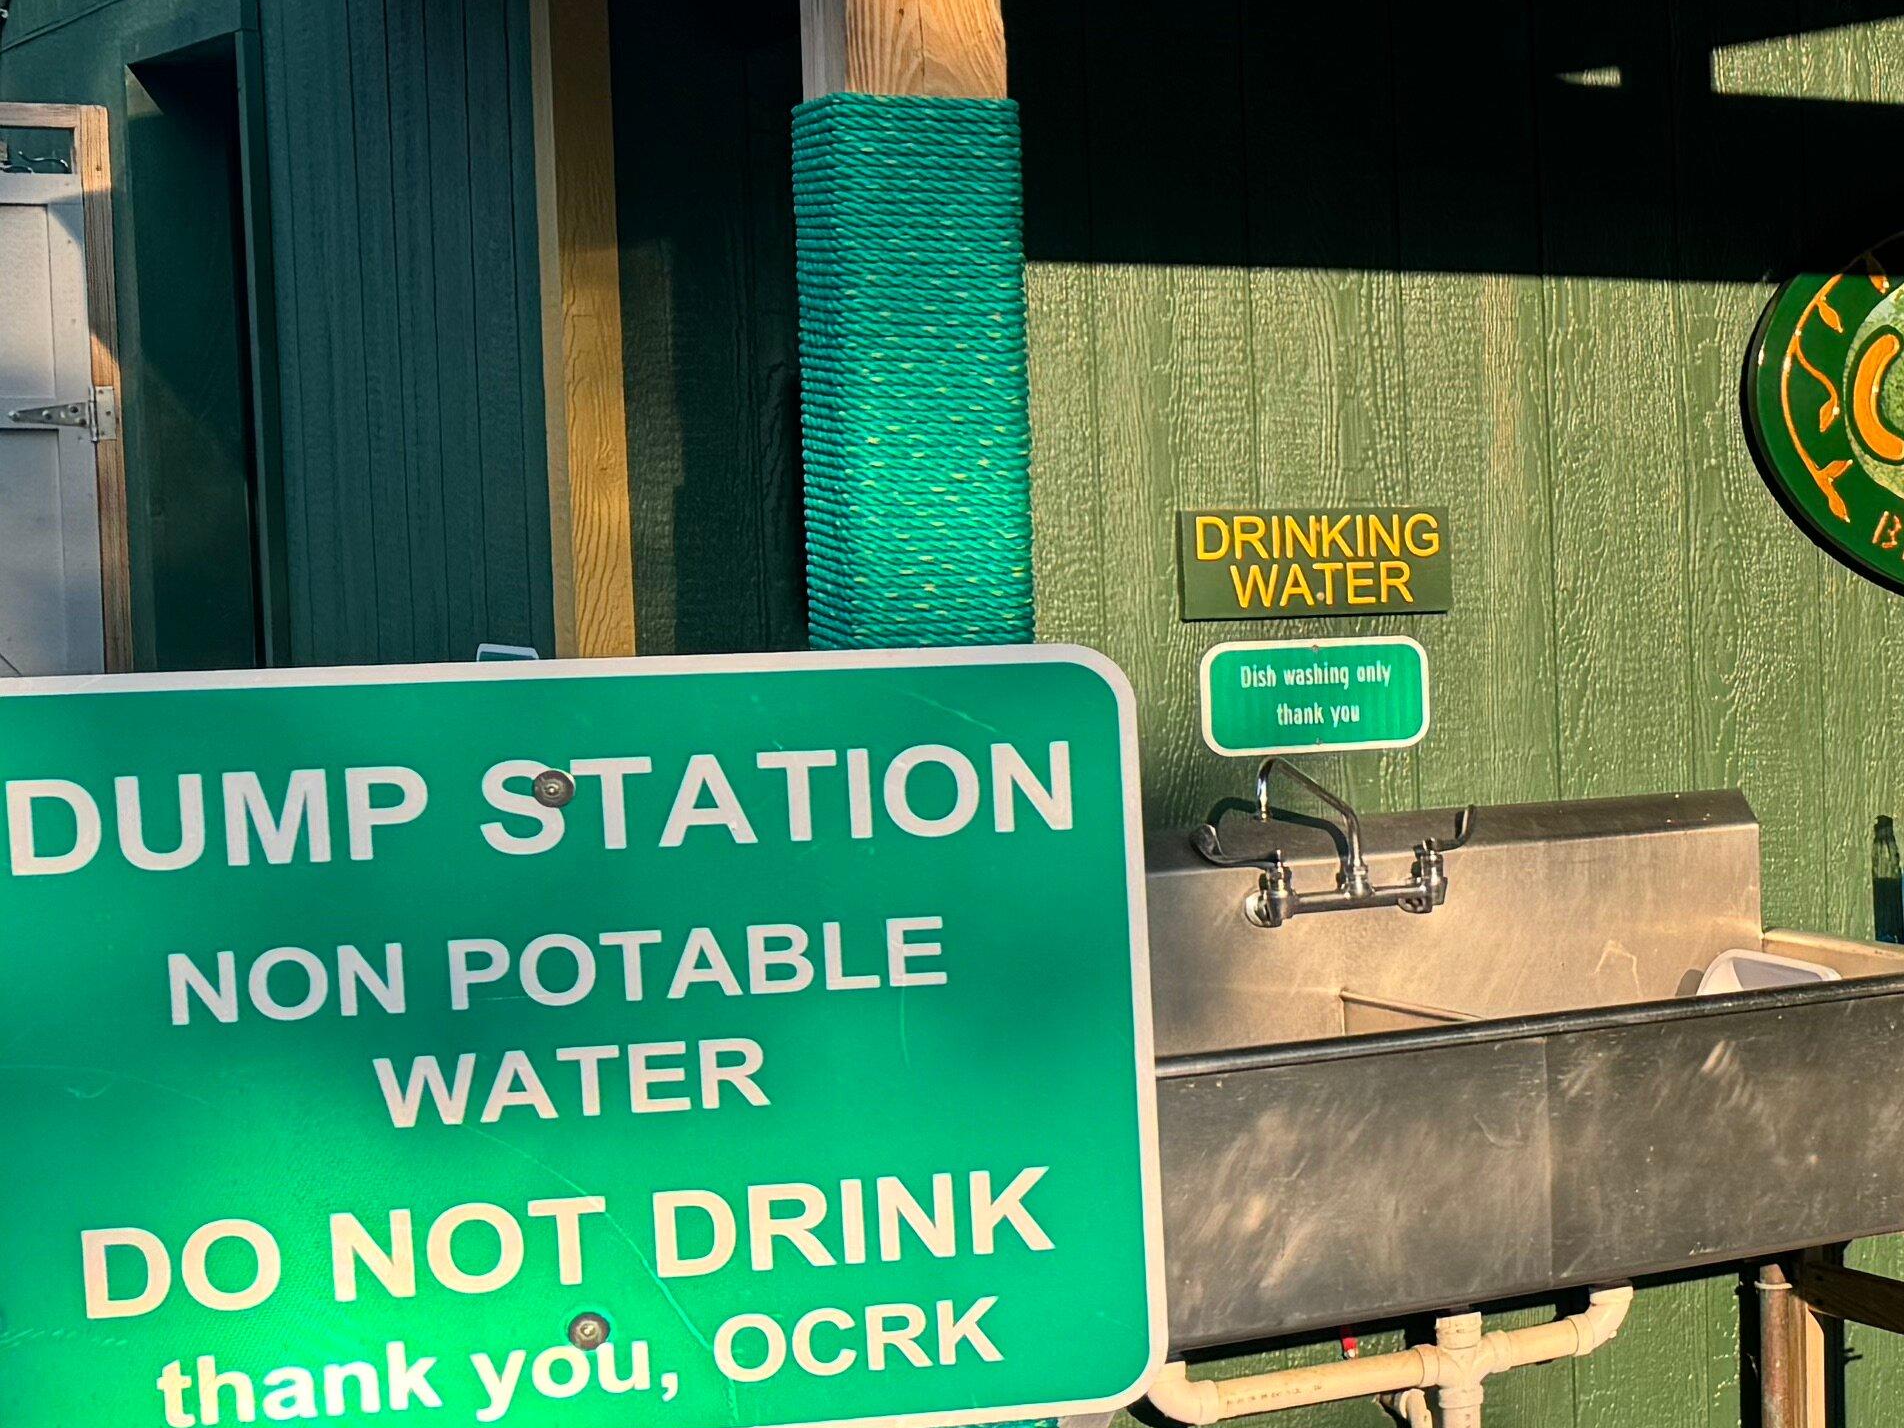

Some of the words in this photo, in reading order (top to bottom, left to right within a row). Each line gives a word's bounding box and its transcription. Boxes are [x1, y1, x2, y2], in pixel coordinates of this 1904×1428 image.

[1195, 513, 1441, 561] DRINKING
[1229, 560, 1414, 609] WATER
[1240, 664, 1277, 689] Dish
[1283, 662, 1349, 690] washing
[1357, 659, 1391, 687] only
[1276, 702, 1324, 727] thank
[1330, 703, 1360, 728] you
[6, 766, 429, 878] DUMP
[479, 739, 1076, 856] STATION
[166, 942, 406, 1026] NON
[448, 915, 949, 1011] POTABLE
[372, 1037, 772, 1130] WATER
[80, 1218, 283, 1322] DO
[329, 1197, 608, 1304] NOT
[652, 1165, 1057, 1279] DRINK
[475, 1338, 681, 1423] you,
[711, 1295, 1006, 1385] OCRK
